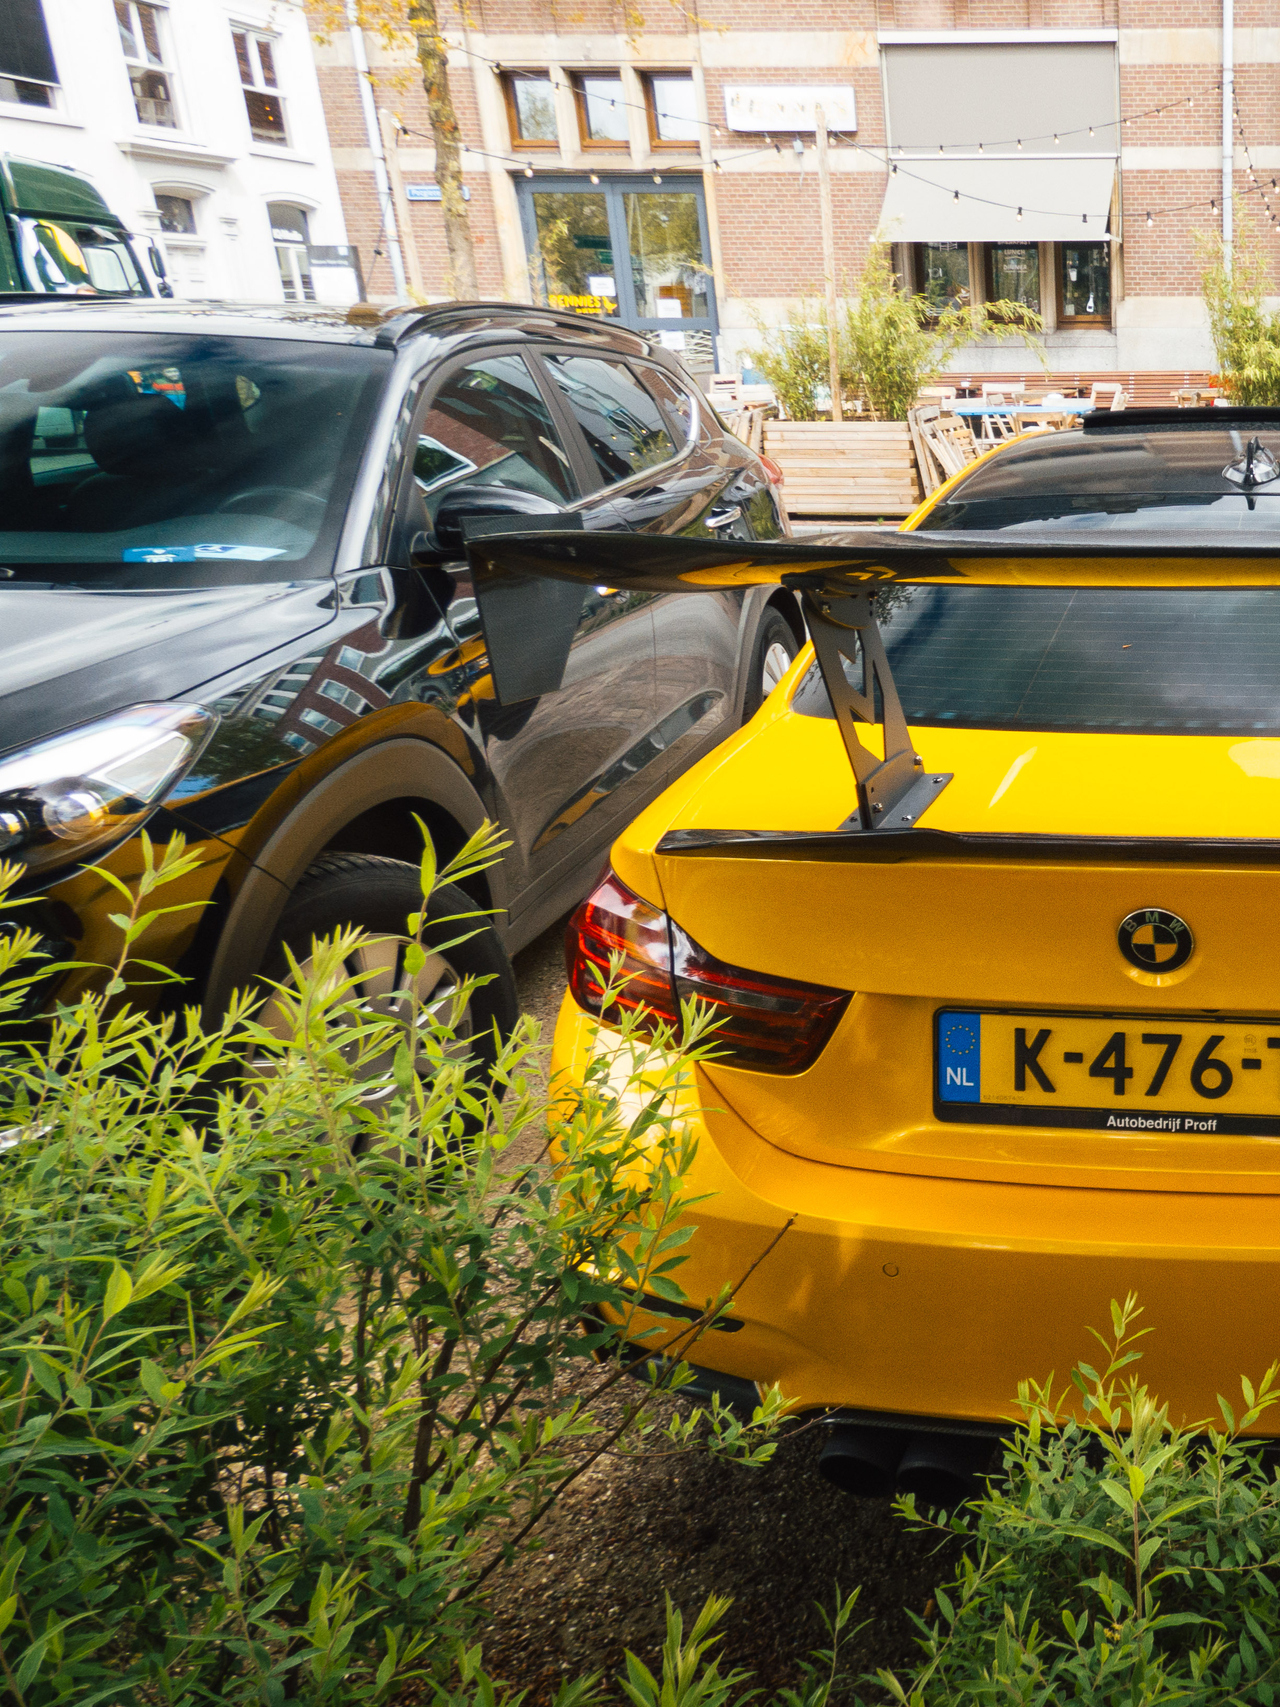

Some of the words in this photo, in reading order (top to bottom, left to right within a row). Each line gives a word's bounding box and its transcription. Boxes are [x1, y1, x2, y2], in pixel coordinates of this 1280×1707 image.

[1123, 911, 1185, 934] BMW
[946, 1066, 974, 1087] NL
[1107, 1115, 1181, 1132] Autobedrijf
[1184, 1118, 1217, 1131] Proff
